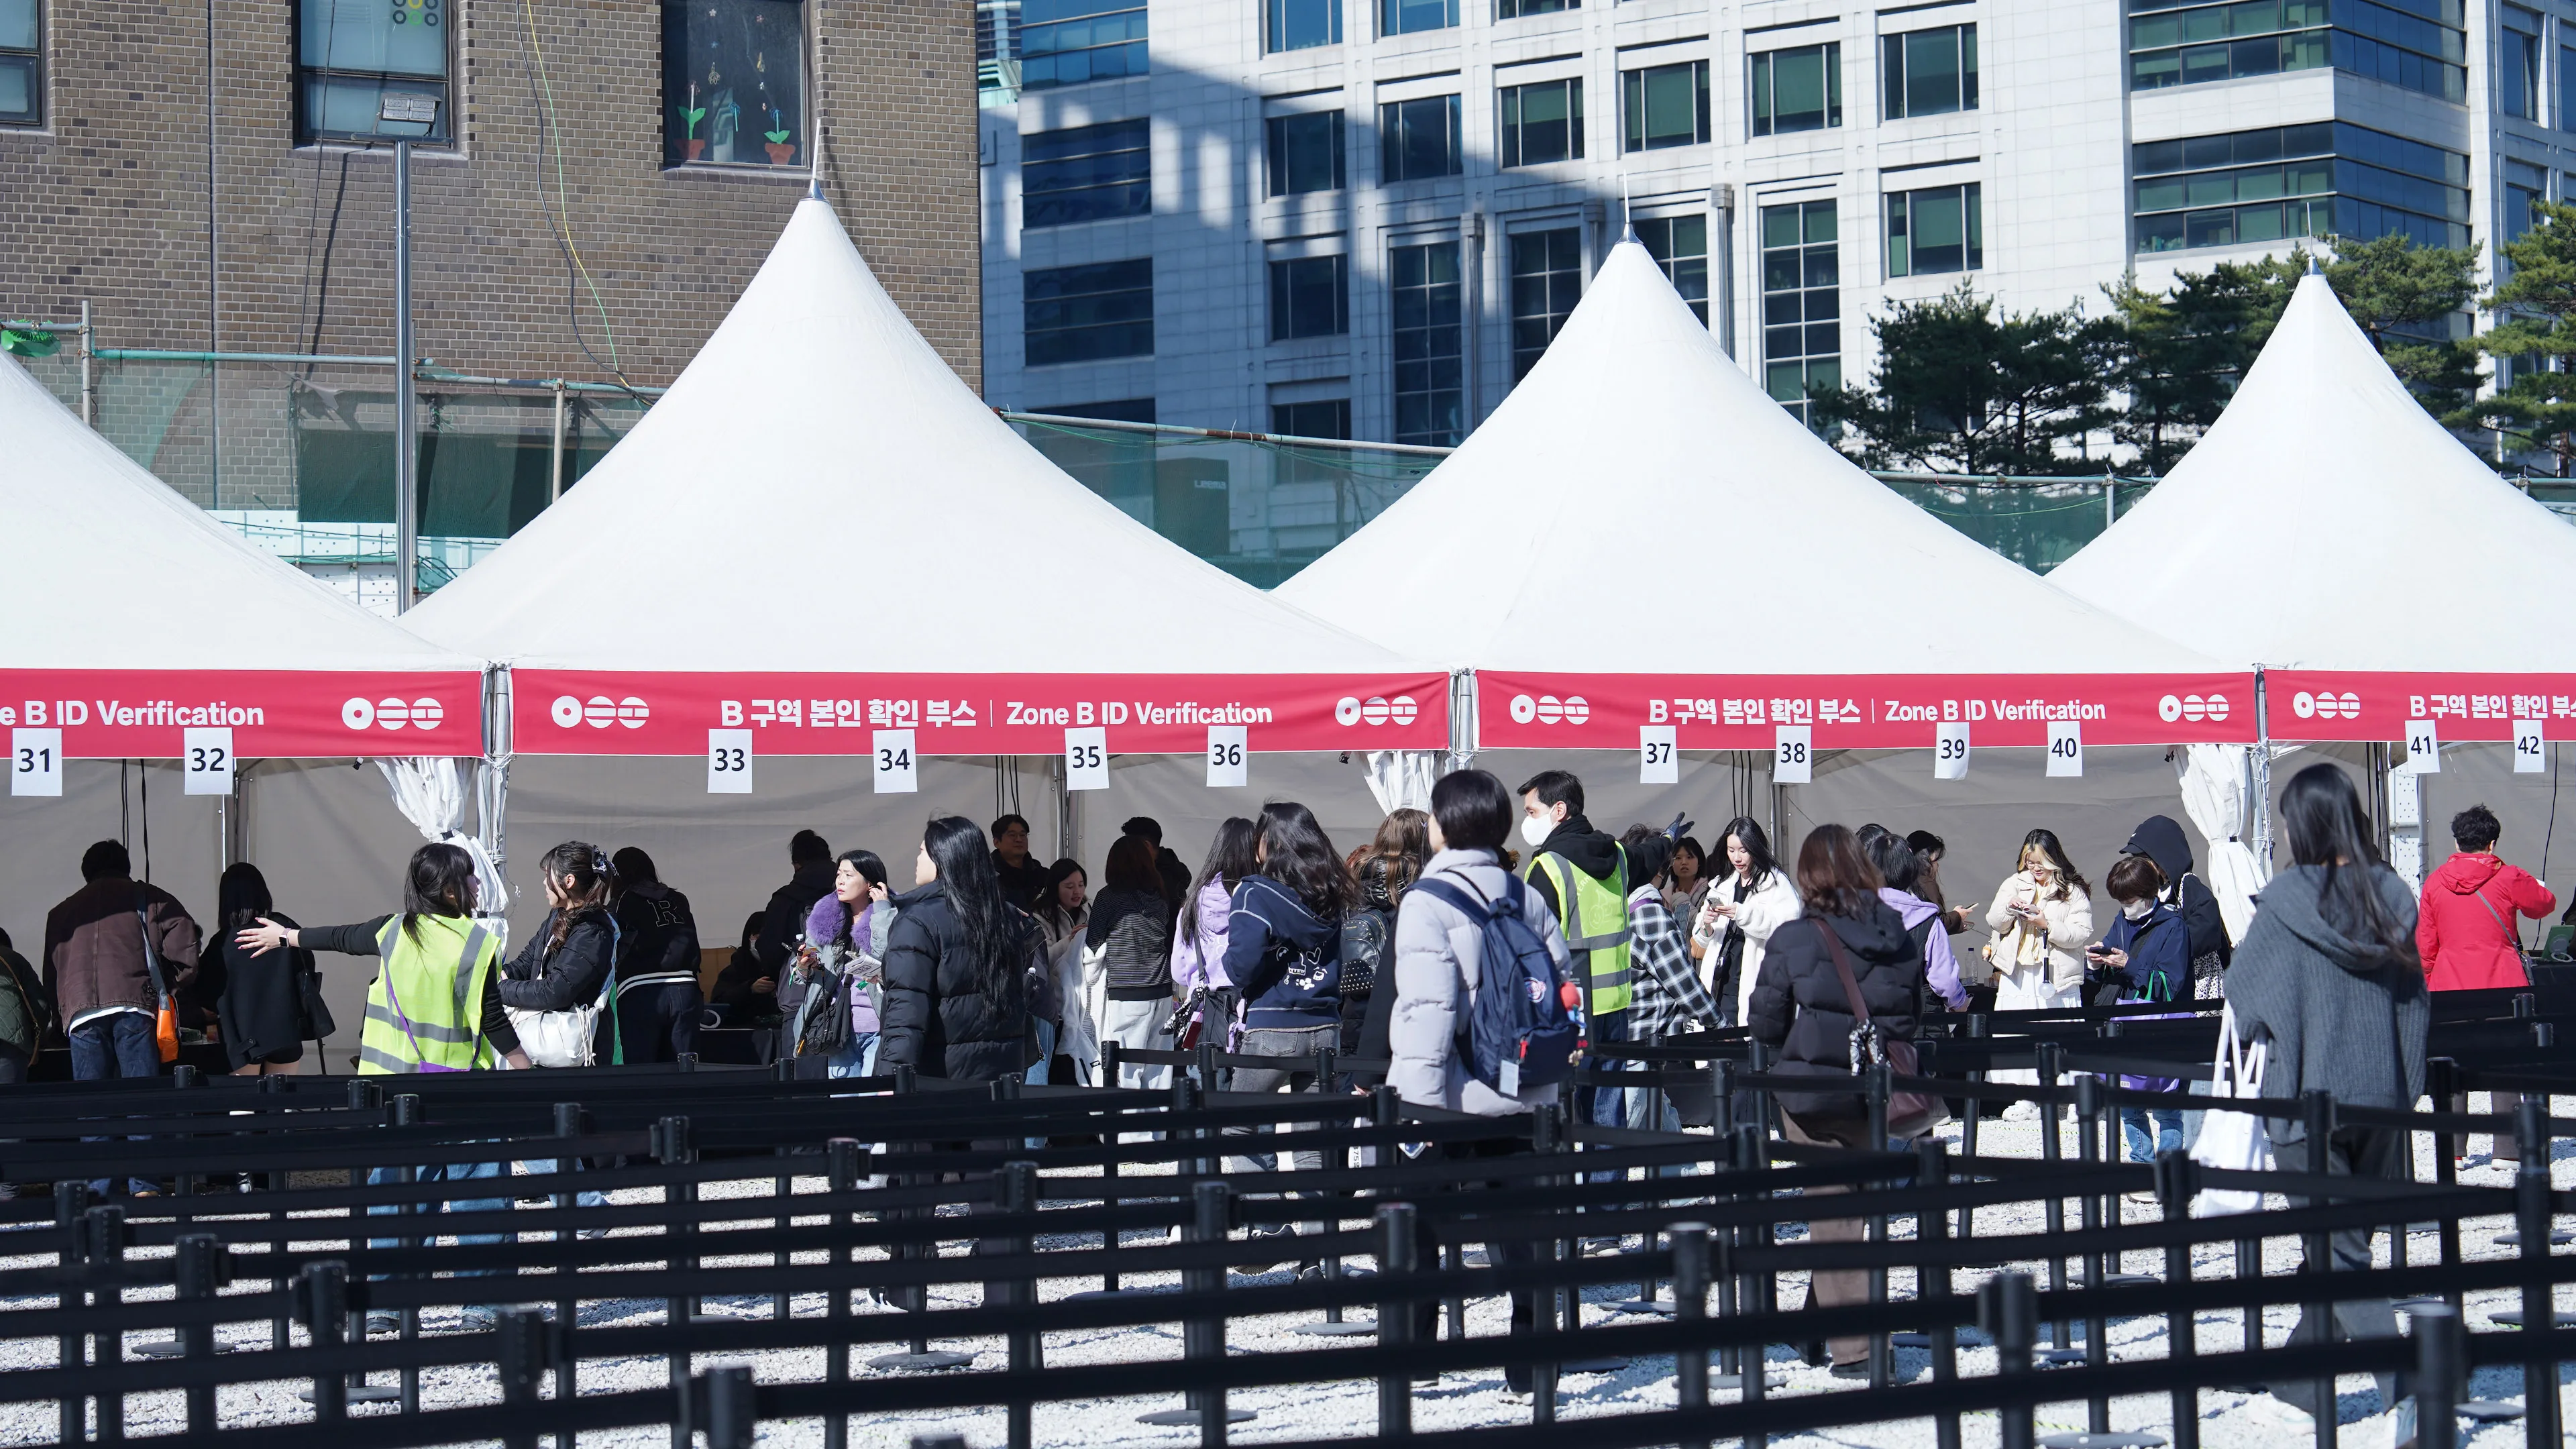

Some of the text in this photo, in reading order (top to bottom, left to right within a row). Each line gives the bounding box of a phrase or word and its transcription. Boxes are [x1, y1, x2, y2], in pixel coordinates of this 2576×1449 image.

[25, 700, 48, 725] B
[56, 700, 89, 725] ID
[96, 700, 264, 726] Verification
[720, 698, 977, 728] B 구역 본인 확인 부스
[1006, 701, 1273, 725] Zone B ID Verification
[1649, 698, 1861, 724] B 구역 본인 확인 부스
[1884, 699, 2106, 722] Zone B ID Verification
[2410, 695, 2426, 717] B
[2430, 694, 2467, 718] 구역
[2471, 694, 2508, 718] 본인
[2511, 694, 2548, 719] 확인
[1213, 743, 1241, 766] 36
[1646, 743, 1671, 764] 37
[1780, 743, 1805, 763] 38
[1941, 739, 1965, 759] 39
[2051, 737, 2077, 757] 40
[2411, 735, 2431, 755] 41
[2518, 736, 2540, 754] 42
[19, 748, 50, 773] 31
[191, 747, 225, 771] 32
[714, 748, 745, 771] 33
[880, 749, 910, 771] 34
[1073, 746, 1100, 769] 35
